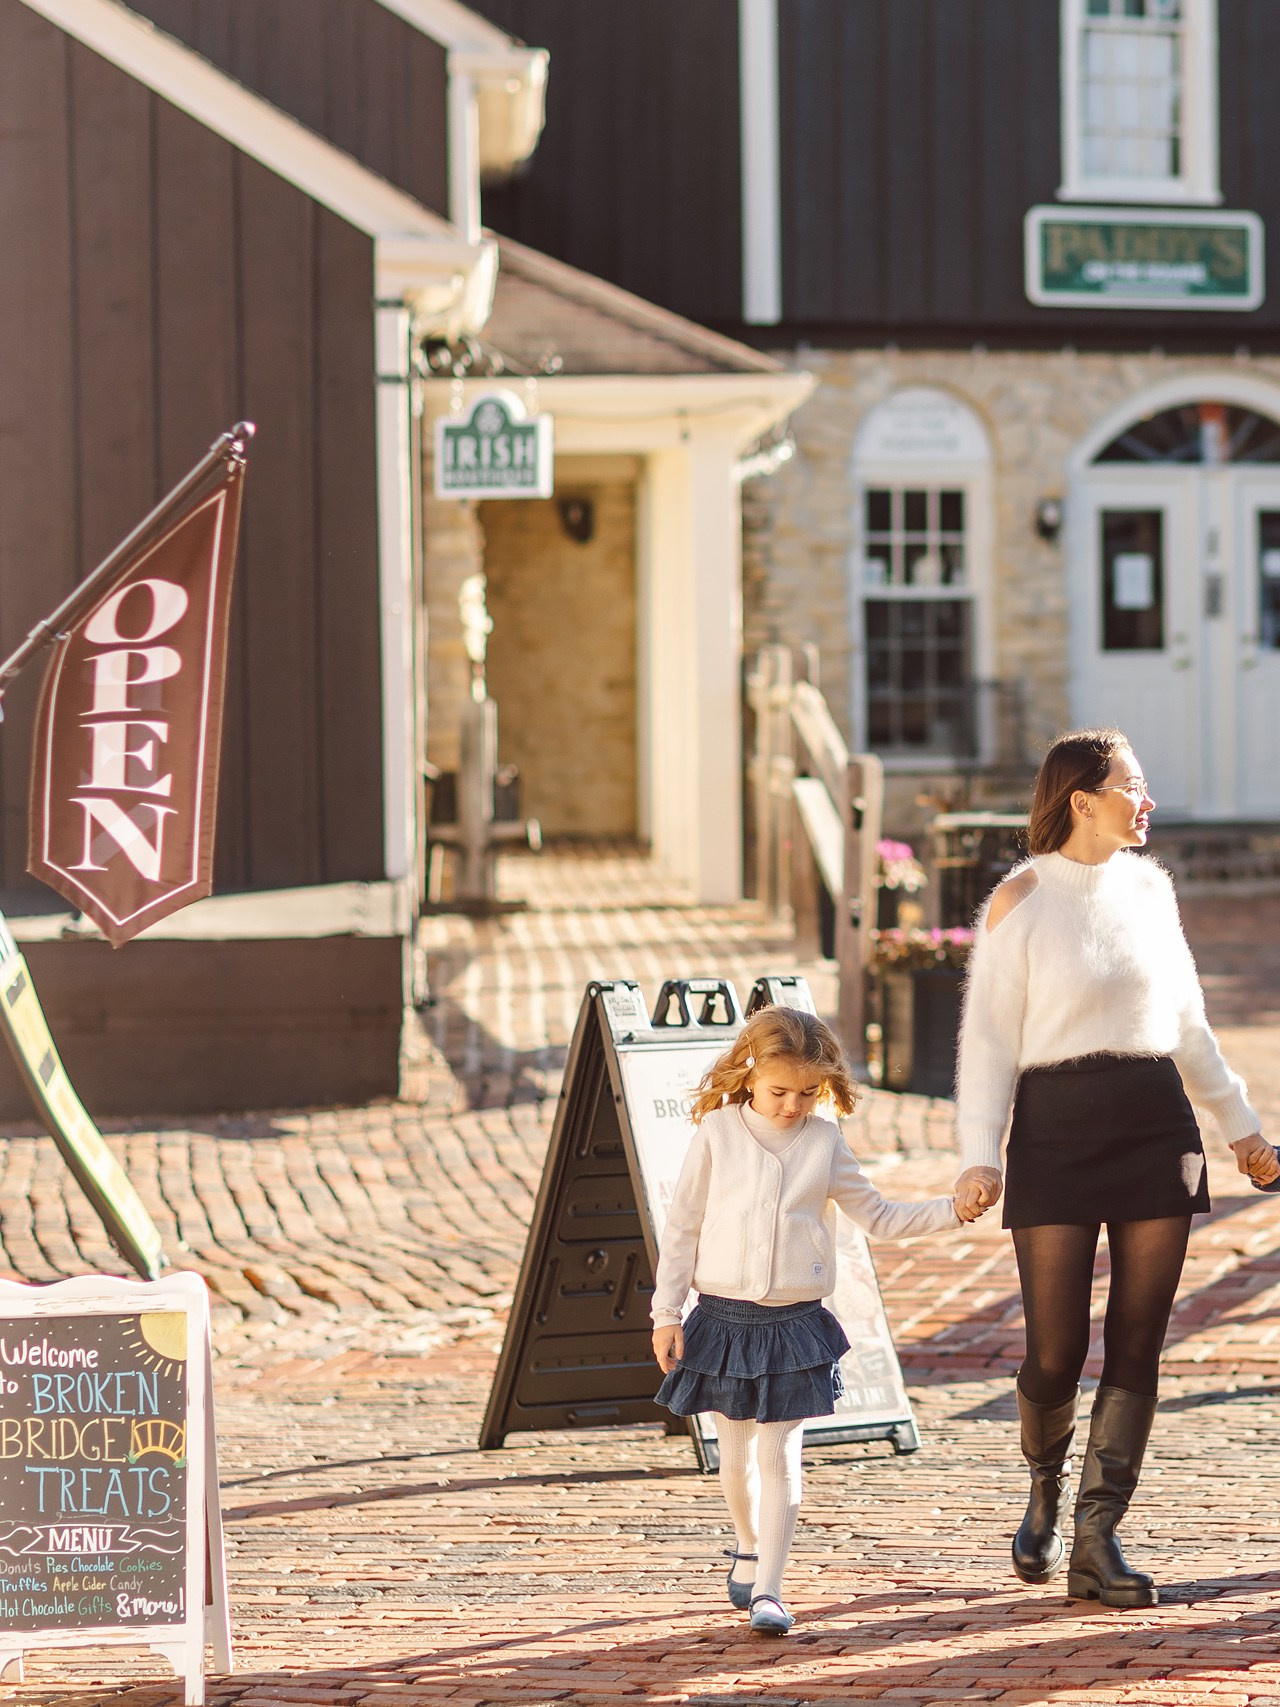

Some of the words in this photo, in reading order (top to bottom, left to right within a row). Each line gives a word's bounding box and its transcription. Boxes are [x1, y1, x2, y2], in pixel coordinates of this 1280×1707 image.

[445, 434, 535, 468] IRISH
[67, 578, 188, 881] OPEN
[0, 1338, 99, 1368] Welcome
[0, 1370, 19, 1394] to
[32, 1370, 160, 1415] BROKEN
[0, 1416, 126, 1462] BRIDGE
[25, 1466, 171, 1517] TREATS
[48, 1527, 113, 1552] MENU
[0, 1557, 41, 1575] Donuts
[46, 1556, 69, 1574] Pies
[71, 1556, 115, 1573] Chocolate
[0, 1577, 48, 1594] Truffles
[53, 1576, 79, 1593] Apple
[82, 1575, 107, 1592] Cider
[110, 1574, 143, 1594] Candy
[0, 1598, 19, 1618] Hot
[22, 1596, 75, 1617] Chocolate
[78, 1595, 112, 1616] Gifts
